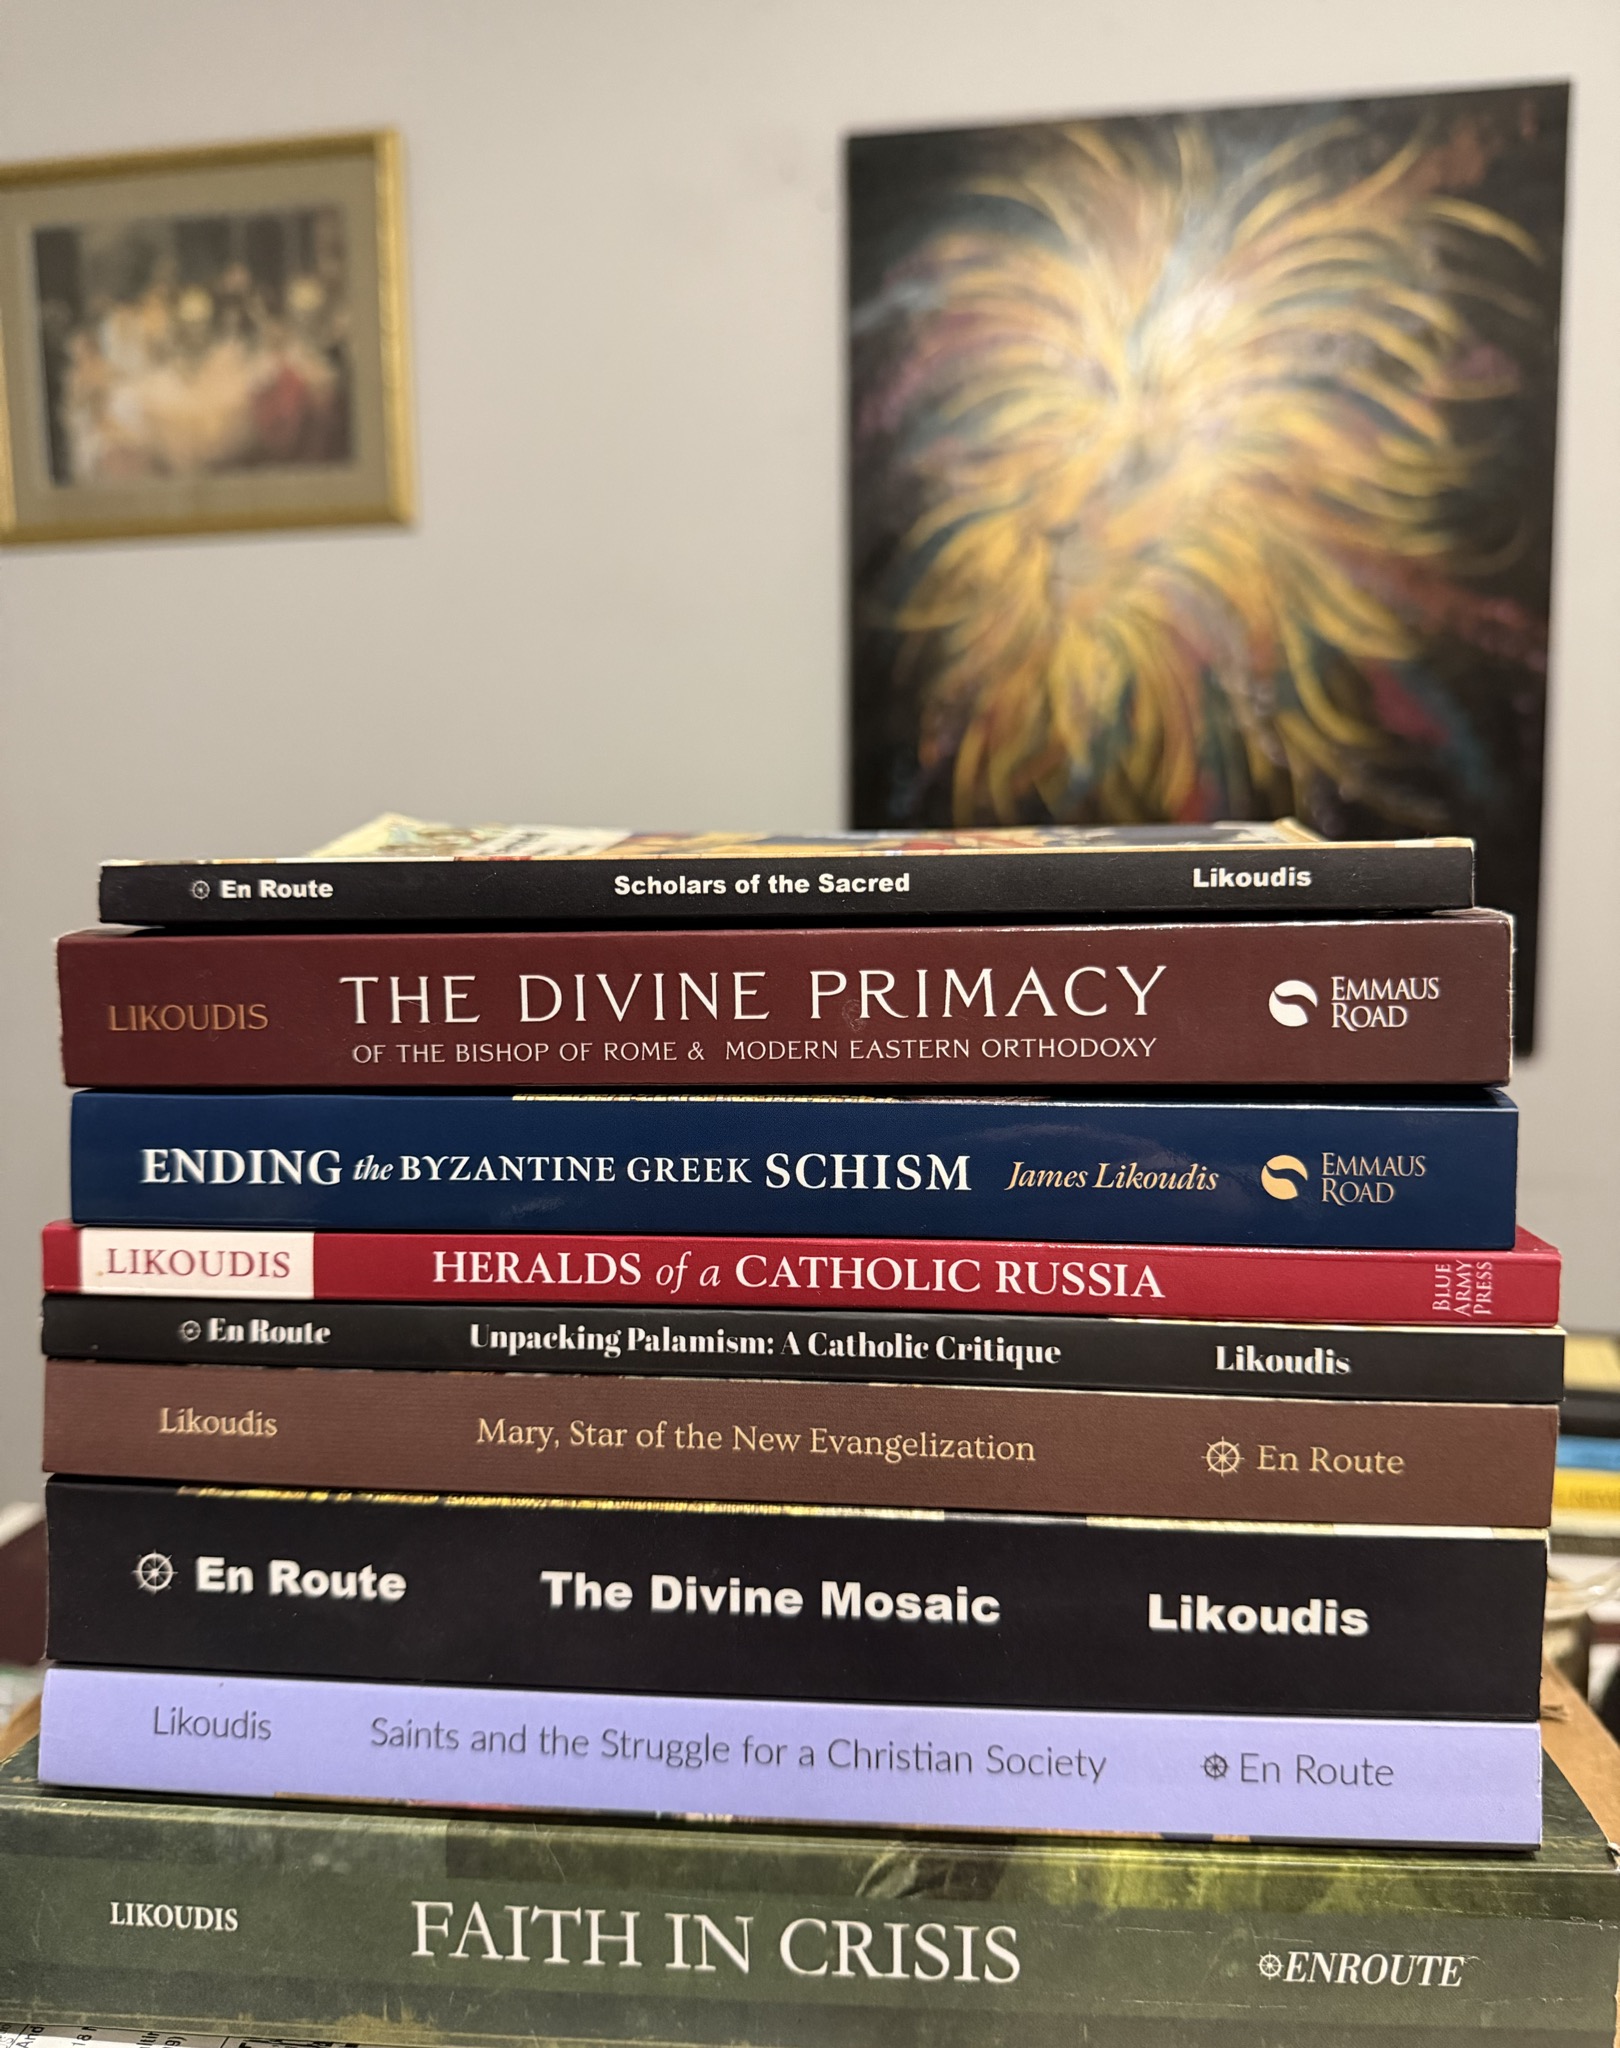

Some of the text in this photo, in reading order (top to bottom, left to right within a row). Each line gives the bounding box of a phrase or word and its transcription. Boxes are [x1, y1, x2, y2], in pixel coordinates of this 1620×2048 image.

[219, 878, 333, 899] En Route
[614, 873, 910, 896] Scholars of the Sacred
[1193, 866, 1312, 888] Likoudis
[339, 965, 1167, 1024] THE DIVINE PRIMACY
[1330, 976, 1441, 1002] EMMAUS
[108, 1003, 269, 1032] LIKOUDIS
[1330, 1002, 1409, 1032] ROAD
[353, 1036, 1158, 1064] OF THE BISHOP OF ROME & MODERN EASTERN ORTHODOXY
[140, 1149, 972, 1192] ENDING the BYZANTINE GREEK SCHISM
[1004, 1160, 1220, 1193] James Likoudis
[1321, 1152, 1426, 1178] EMMAUS
[1321, 1176, 1395, 1206] ROAD
[106, 1248, 291, 1279] LIKOUDIS
[432, 1250, 1166, 1299] HERALDS of a CATHOLIC RUSSIA
[1432, 1264, 1452, 1311] BLUE
[1453, 1260, 1473, 1317] ARMY
[1473, 1262, 1494, 1315] PRESS
[208, 1319, 331, 1345] En Route
[469, 1323, 1062, 1369] Unpacking Palamism: A Catholic Critique
[1214, 1345, 1352, 1375] Likoudis
[158, 1408, 278, 1437] Likoudis
[477, 1418, 1036, 1463] Mary, Star of the New Evangelization
[1257, 1446, 1405, 1476] En Route
[195, 1556, 406, 1601] En Route
[540, 1570, 1001, 1625] The Divine Mosaic
[1146, 1593, 1370, 1637] Likoudis
[153, 1706, 273, 1742] Likoudis
[370, 1718, 1107, 1783] Saints and the Struggle for a Christian Society
[1239, 1752, 1395, 1788] En Route
[109, 1902, 238, 1933] LIKOUDIS
[410, 1900, 1021, 1984] FAITH IN CRISIS
[1283, 1952, 1465, 1989] ENROUTE
